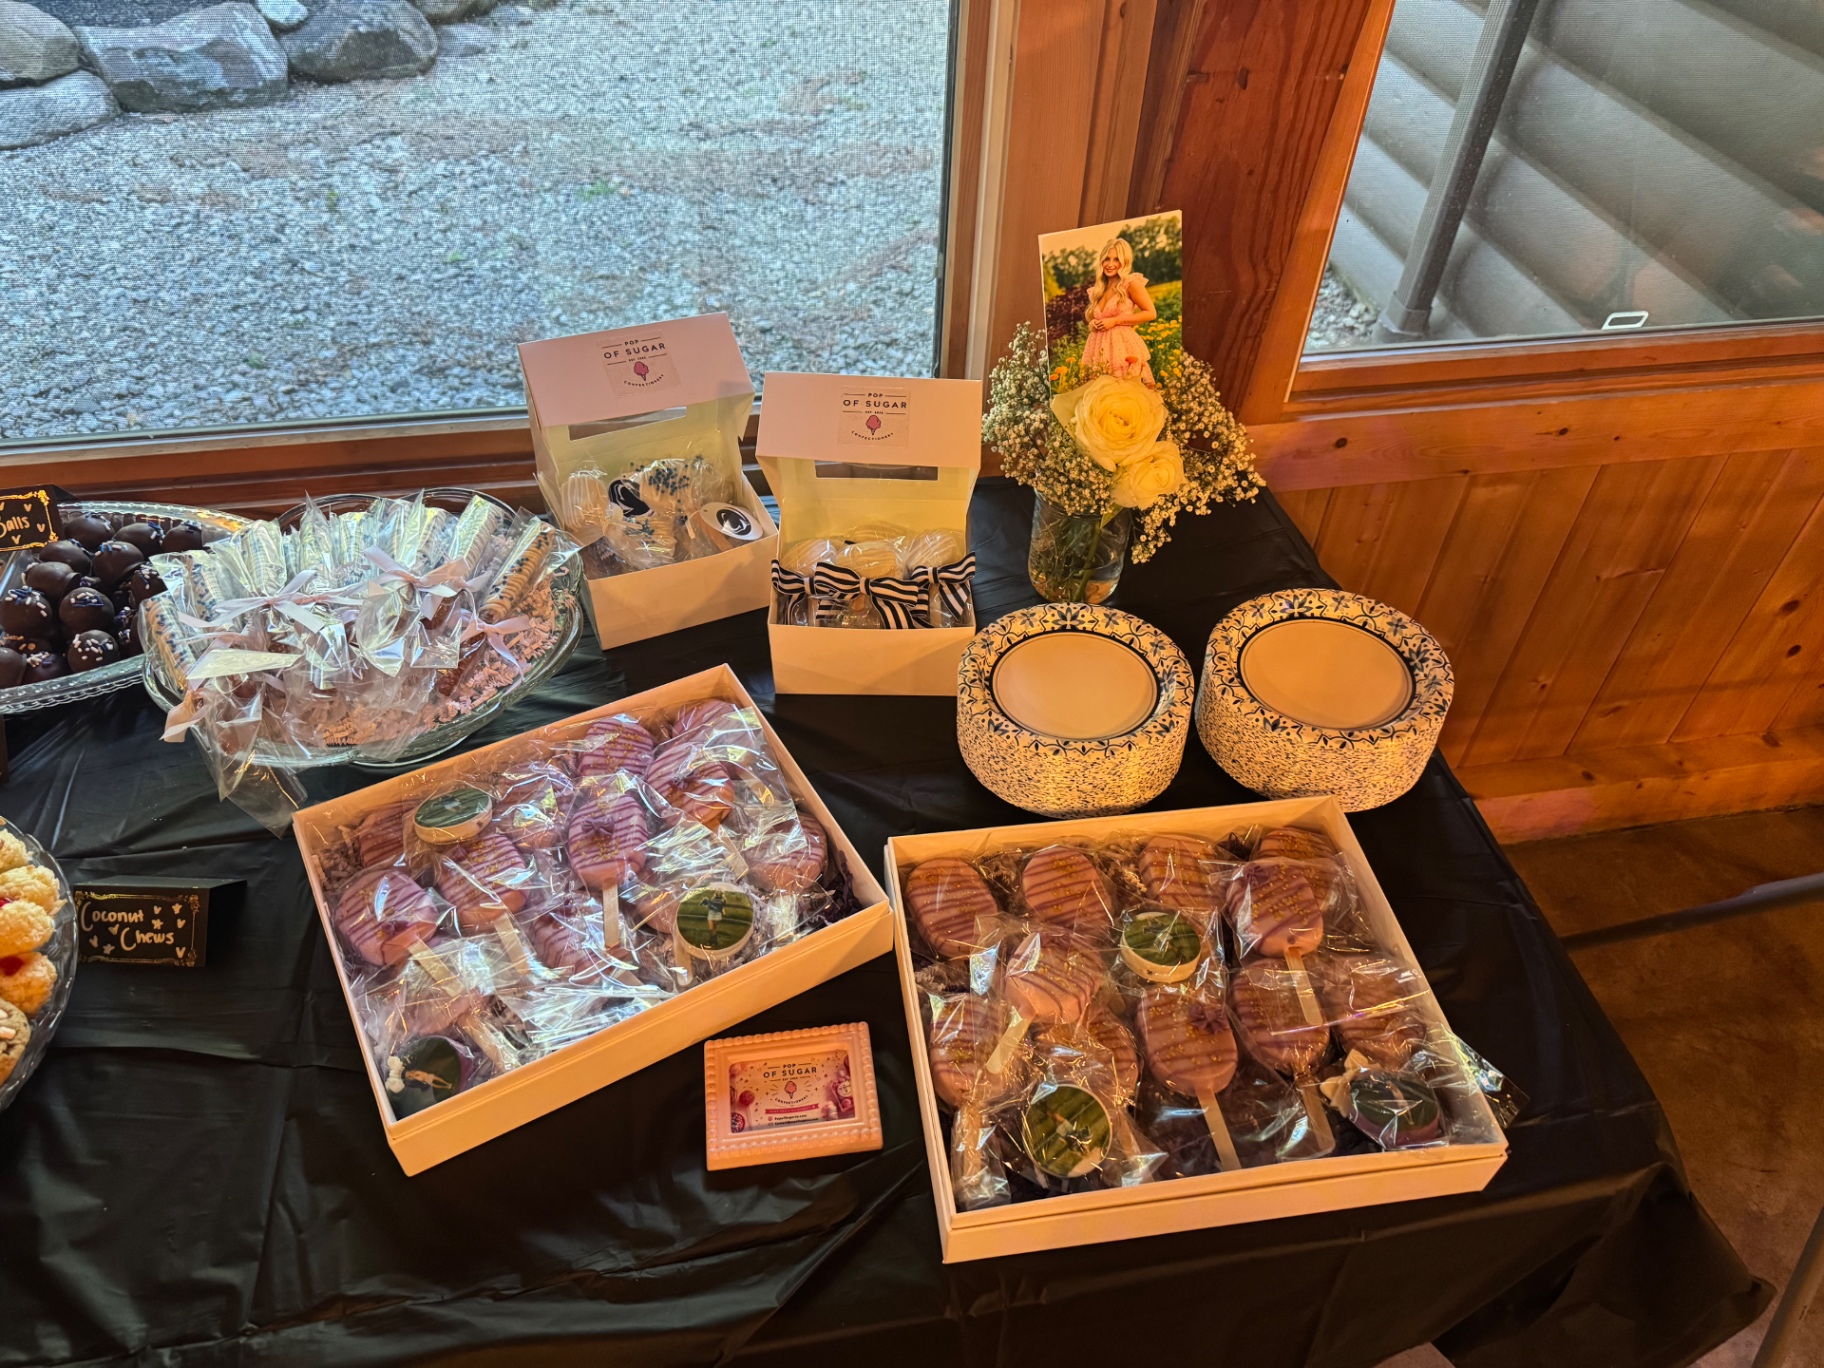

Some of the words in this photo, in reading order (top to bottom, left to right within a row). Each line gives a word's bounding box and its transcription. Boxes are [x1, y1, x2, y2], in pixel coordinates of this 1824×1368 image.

[604, 351, 619, 359] OF
[625, 343, 666, 356] SUGAR
[843, 399, 860, 407] OF
[865, 400, 907, 409] SUGAR
[80, 901, 144, 931] Coconut
[120, 927, 175, 951] Chews
[763, 1071, 777, 1079] OF
[782, 1066, 818, 1077] SUGAR
